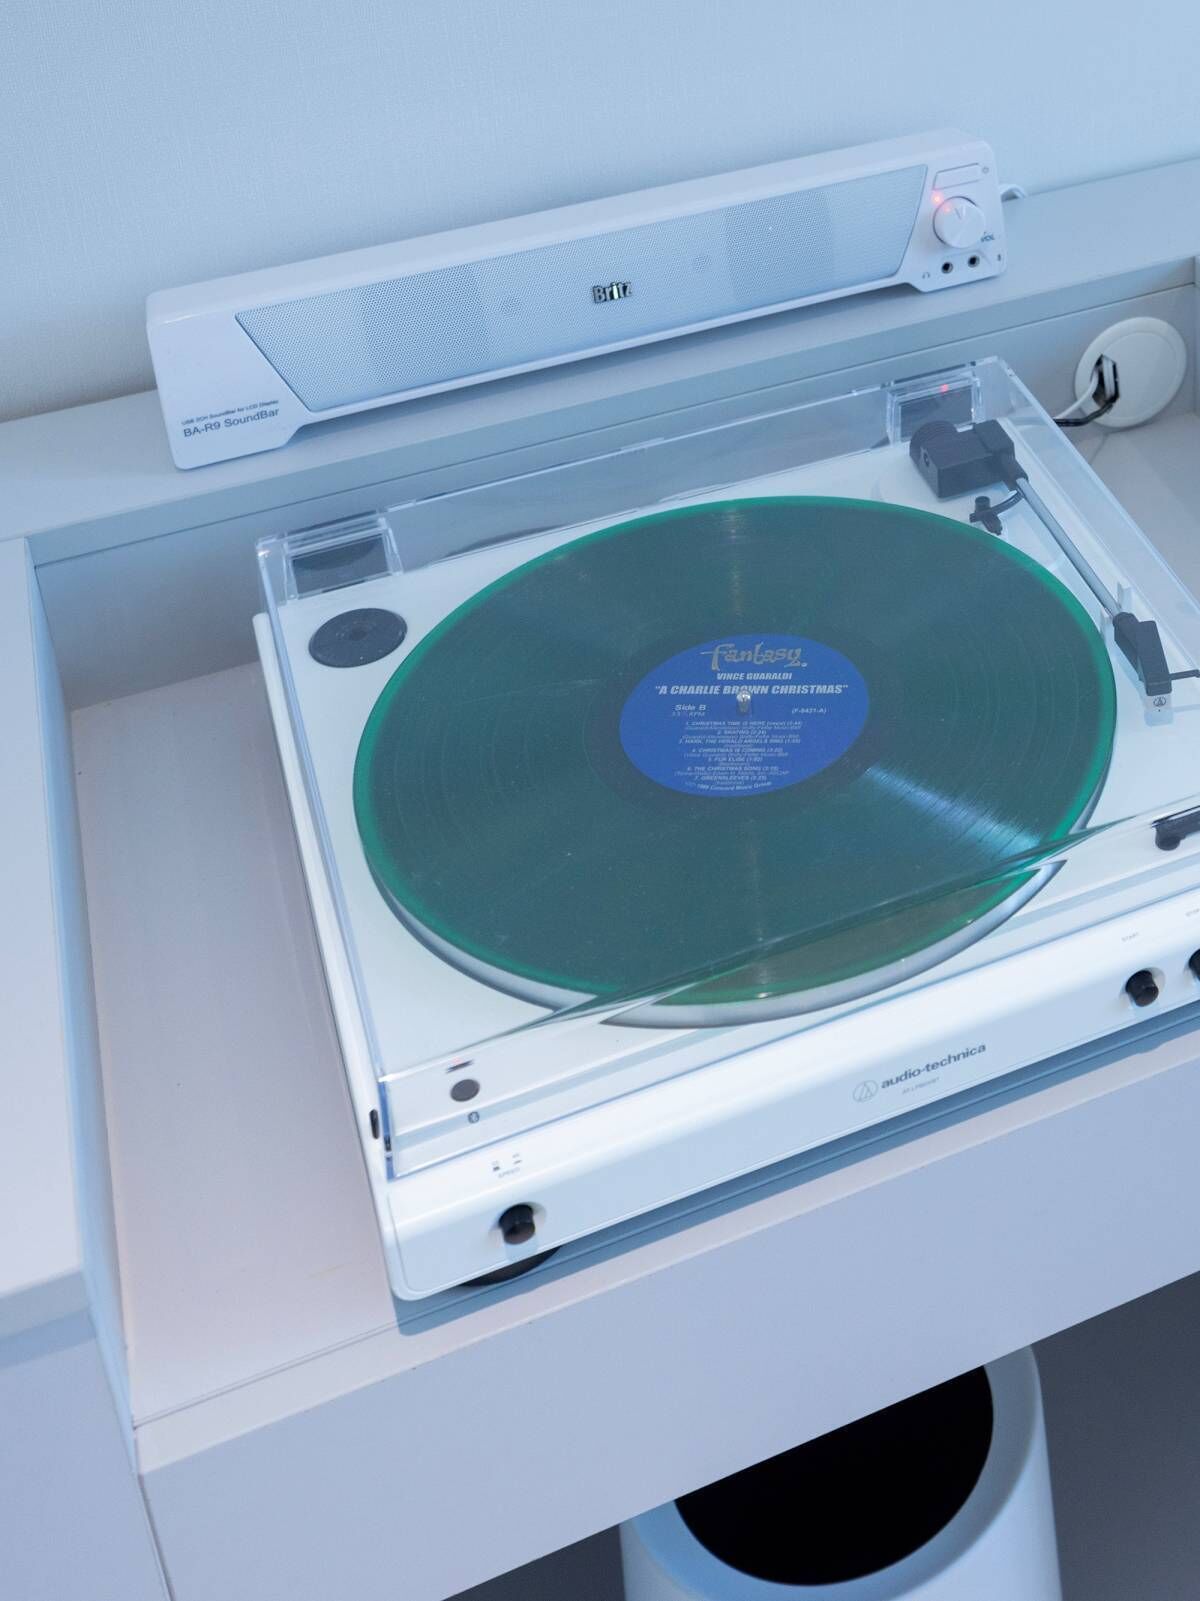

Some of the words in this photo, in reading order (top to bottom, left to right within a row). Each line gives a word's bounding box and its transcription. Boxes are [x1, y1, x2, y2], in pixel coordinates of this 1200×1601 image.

[592, 281, 633, 304] Britz
[183, 420, 221, 437] BA-R9
[224, 408, 280, 428] SoundBar
[716, 672, 745, 681] VINCE
[746, 672, 793, 681] GUARALDI
[670, 685, 721, 695] CHARLIE
[771, 684, 849, 695] CHRISTMAS"
[674, 703, 697, 711] Side
[698, 703, 707, 711] B
[881, 1044, 986, 1089] audio-technica
